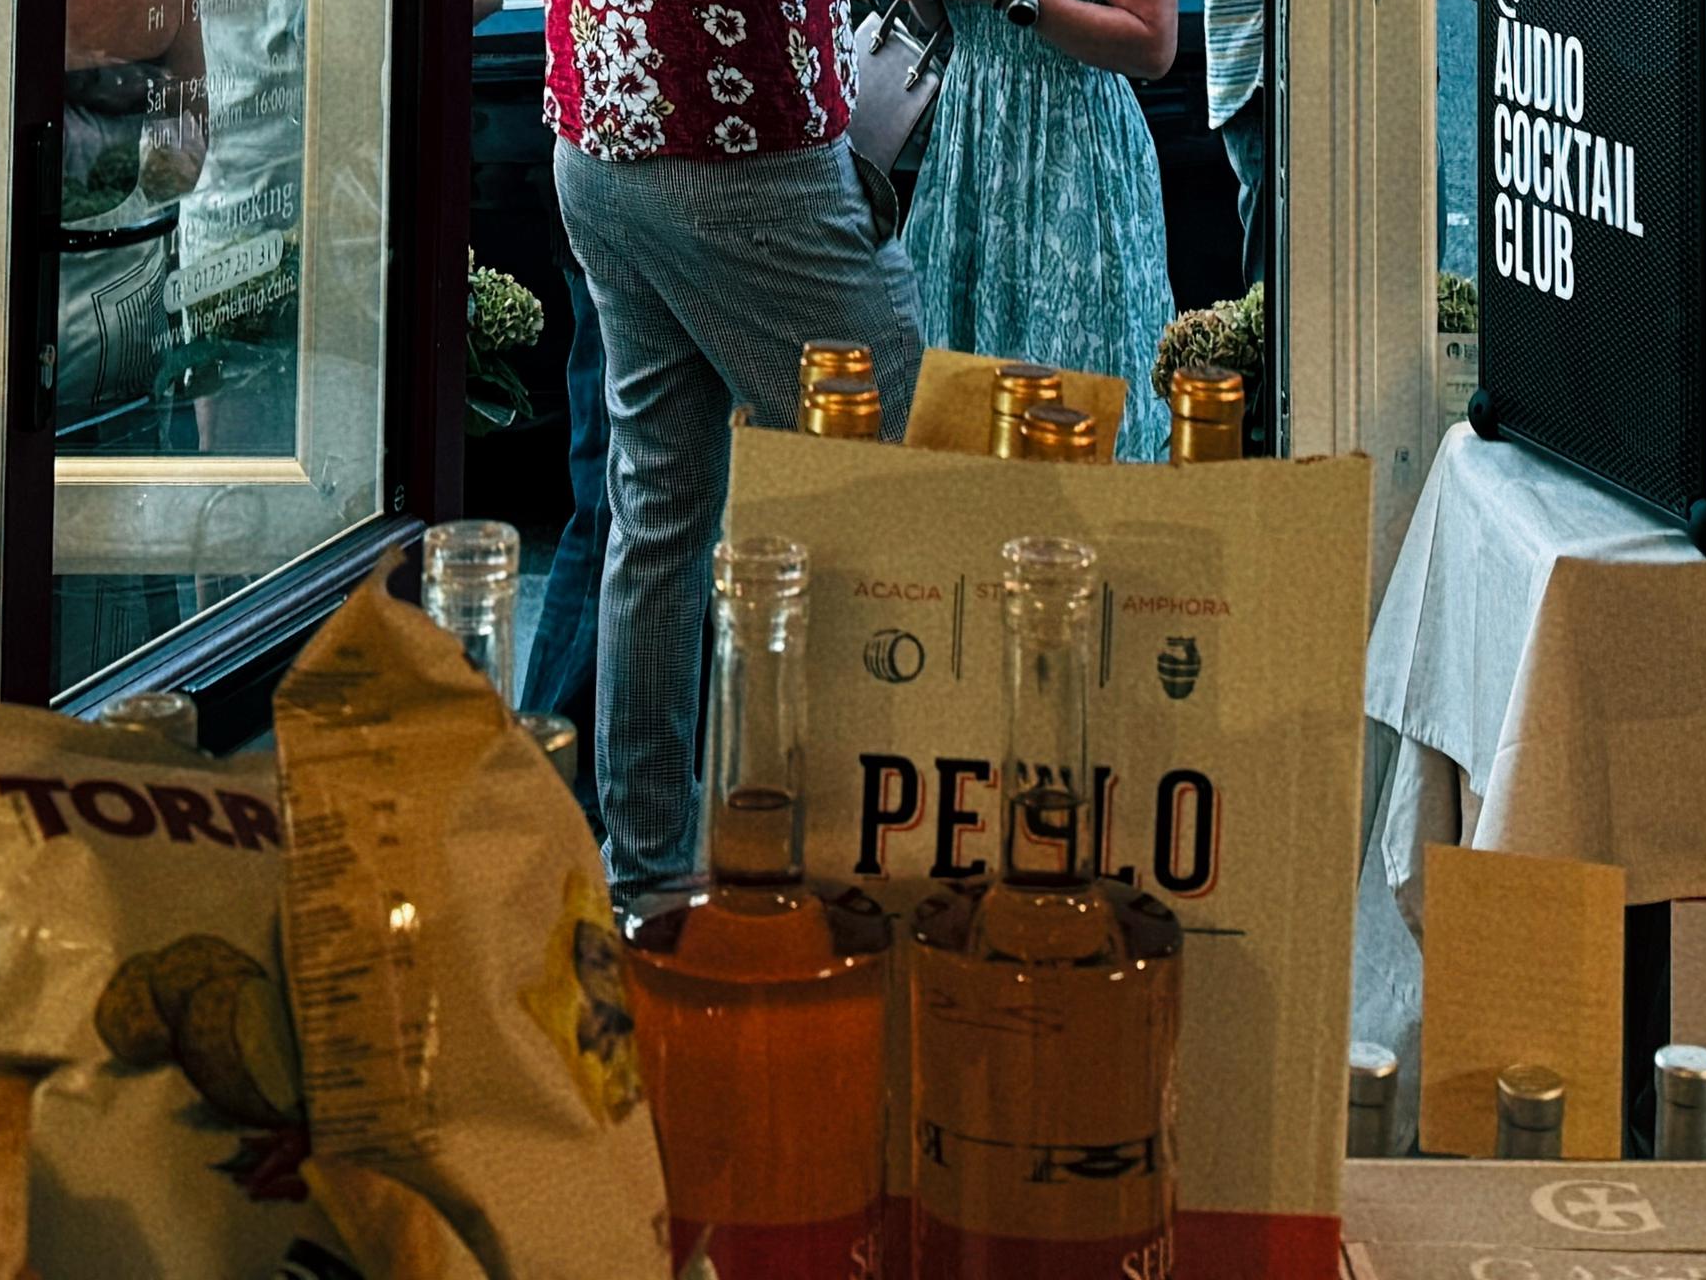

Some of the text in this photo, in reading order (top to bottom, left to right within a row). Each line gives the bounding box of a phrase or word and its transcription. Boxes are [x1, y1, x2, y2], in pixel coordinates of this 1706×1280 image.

[1494, 17, 1584, 123] AUDIO
[1494, 104, 1644, 238] COCKTAIL
[1494, 192, 1574, 300] CLUB
[854, 581, 942, 602] ACACIA
[1122, 594, 1231, 618] AMPHORA
